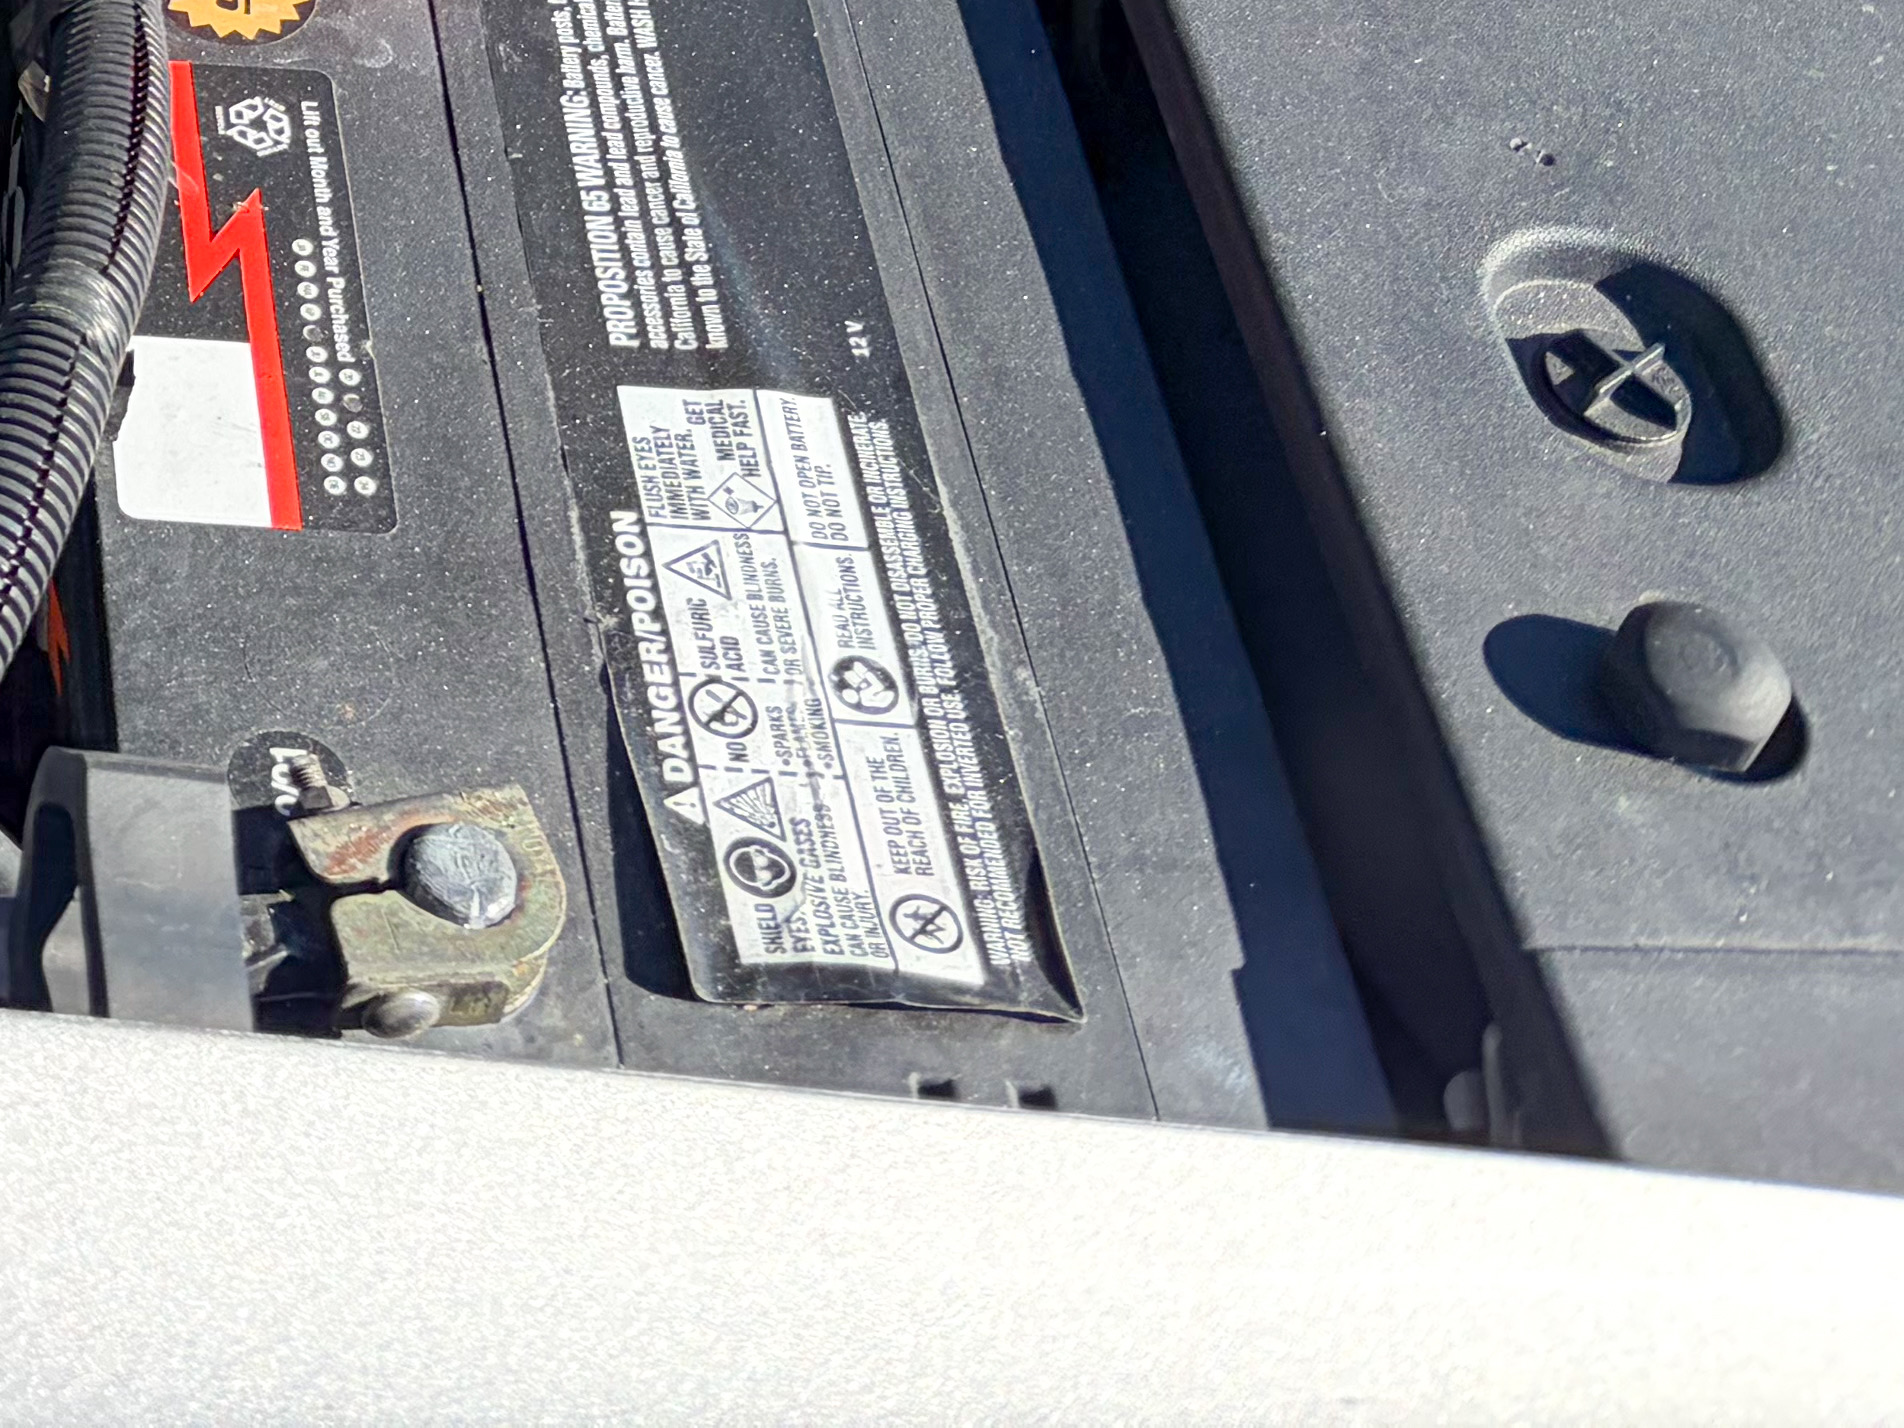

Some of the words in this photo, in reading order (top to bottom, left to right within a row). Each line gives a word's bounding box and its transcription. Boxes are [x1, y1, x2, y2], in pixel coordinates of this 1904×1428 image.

[550, 6, 579, 42] posts,
[629, 8, 657, 48] WASH
[560, 45, 585, 88] Battery
[613, 39, 636, 74] harm.
[643, 51, 668, 95] cancer.
[587, 54, 621, 129] compounds,
[300, 100, 320, 125] Lift
[619, 75, 654, 152] reproductive
[652, 96, 677, 133] cause
[304, 128, 324, 153] out
[560, 90, 605, 186] WARNING:
[601, 131, 627, 159] lead
[659, 134, 680, 148] to
[308, 156, 332, 203] Month
[607, 161, 633, 186] and
[633, 155, 659, 178] and
[662, 148, 696, 209] California
[579, 189, 611, 210] 65
[613, 187, 639, 216] lead
[644, 181, 670, 224] cancer
[675, 211, 700, 224] of
[316, 205, 339, 236] and
[321, 238, 339, 273] Year
[621, 219, 651, 267] contain
[654, 227, 678, 265] cause
[681, 227, 708, 261] State
[584, 214, 640, 347] PROPOSITION
[661, 268, 682, 281] to
[690, 264, 713, 285] the
[633, 269, 669, 348] accessories
[695, 288, 718, 301] to
[325, 277, 355, 362] Purchased
[663, 284, 698, 349] California
[701, 304, 728, 348] known
[844, 320, 863, 332] V
[848, 336, 869, 356] 12
[682, 399, 706, 424] GET
[704, 399, 735, 460] MEDICAL
[729, 399, 752, 436] FAST.
[779, 397, 808, 451] BATTERY.
[631, 436, 656, 470] EYES
[675, 428, 702, 480] WATER.
[736, 441, 761, 477] HELP
[792, 454, 816, 488] OPEN
[868, 419, 909, 508] INSTRUCTIONS.
[649, 425, 688, 519] IMMEDIATELY
[814, 463, 835, 485] TIP.
[640, 475, 667, 518] FLUSH
[685, 485, 711, 520] WITH
[801, 491, 822, 517] NOT
[819, 490, 842, 517] NOT
[868, 485, 887, 503] OR
[808, 521, 828, 539] DO
[827, 522, 848, 540] DO
[874, 506, 910, 590] DISASSEMBLE
[892, 512, 926, 575] CHARGING
[732, 532, 763, 600] BLINDNESS
[760, 557, 786, 602] BURNS.
[836, 553, 876, 649] INSTRUCTIONS.
[894, 595, 917, 619] NOT
[914, 578, 942, 629] PROPER
[686, 597, 720, 669] SULFURIC
[749, 604, 773, 644] CAUSE
[770, 606, 797, 654] SEVERE
[903, 623, 923, 640] DO
[609, 511, 693, 783] DANGER/POISON
[719, 635, 745, 672] ACID
[759, 649, 780, 674] CAN
[923, 631, 957, 685] FOLLOW
[783, 658, 802, 675] OR
[922, 697, 941, 717] OR
[765, 705, 793, 758] SPARKS
[804, 697, 834, 760] SMOKING
[726, 741, 749, 762] NO
[865, 756, 888, 781] THE
[880, 732, 916, 802] CHILDREN.
[927, 719, 965, 794] EXPLOSION
[948, 723, 983, 787] INVERTED
[873, 785, 895, 802] OF
[968, 789, 992, 818] FOR
[878, 807, 903, 835] OUT
[899, 807, 922, 825] OF
[788, 816, 821, 868] GASES
[813, 802, 847, 882] BLINDNESS
[887, 839, 912, 874] KEEP
[905, 830, 934, 875] REACH
[958, 836, 980, 855] OF
[965, 858, 990, 890] RISK
[978, 821, 1021, 929] RECOMMENDED
[802, 871, 845, 955] EXPLOSIVE
[832, 887, 861, 929] CAUSE
[853, 889, 883, 937] INJURY.
[754, 903, 787, 953] SHIELD
[844, 933, 869, 956] CAN
[974, 895, 1011, 964] WARNING:
[1007, 932, 1032, 961] NOT
[867, 942, 889, 957] OR
